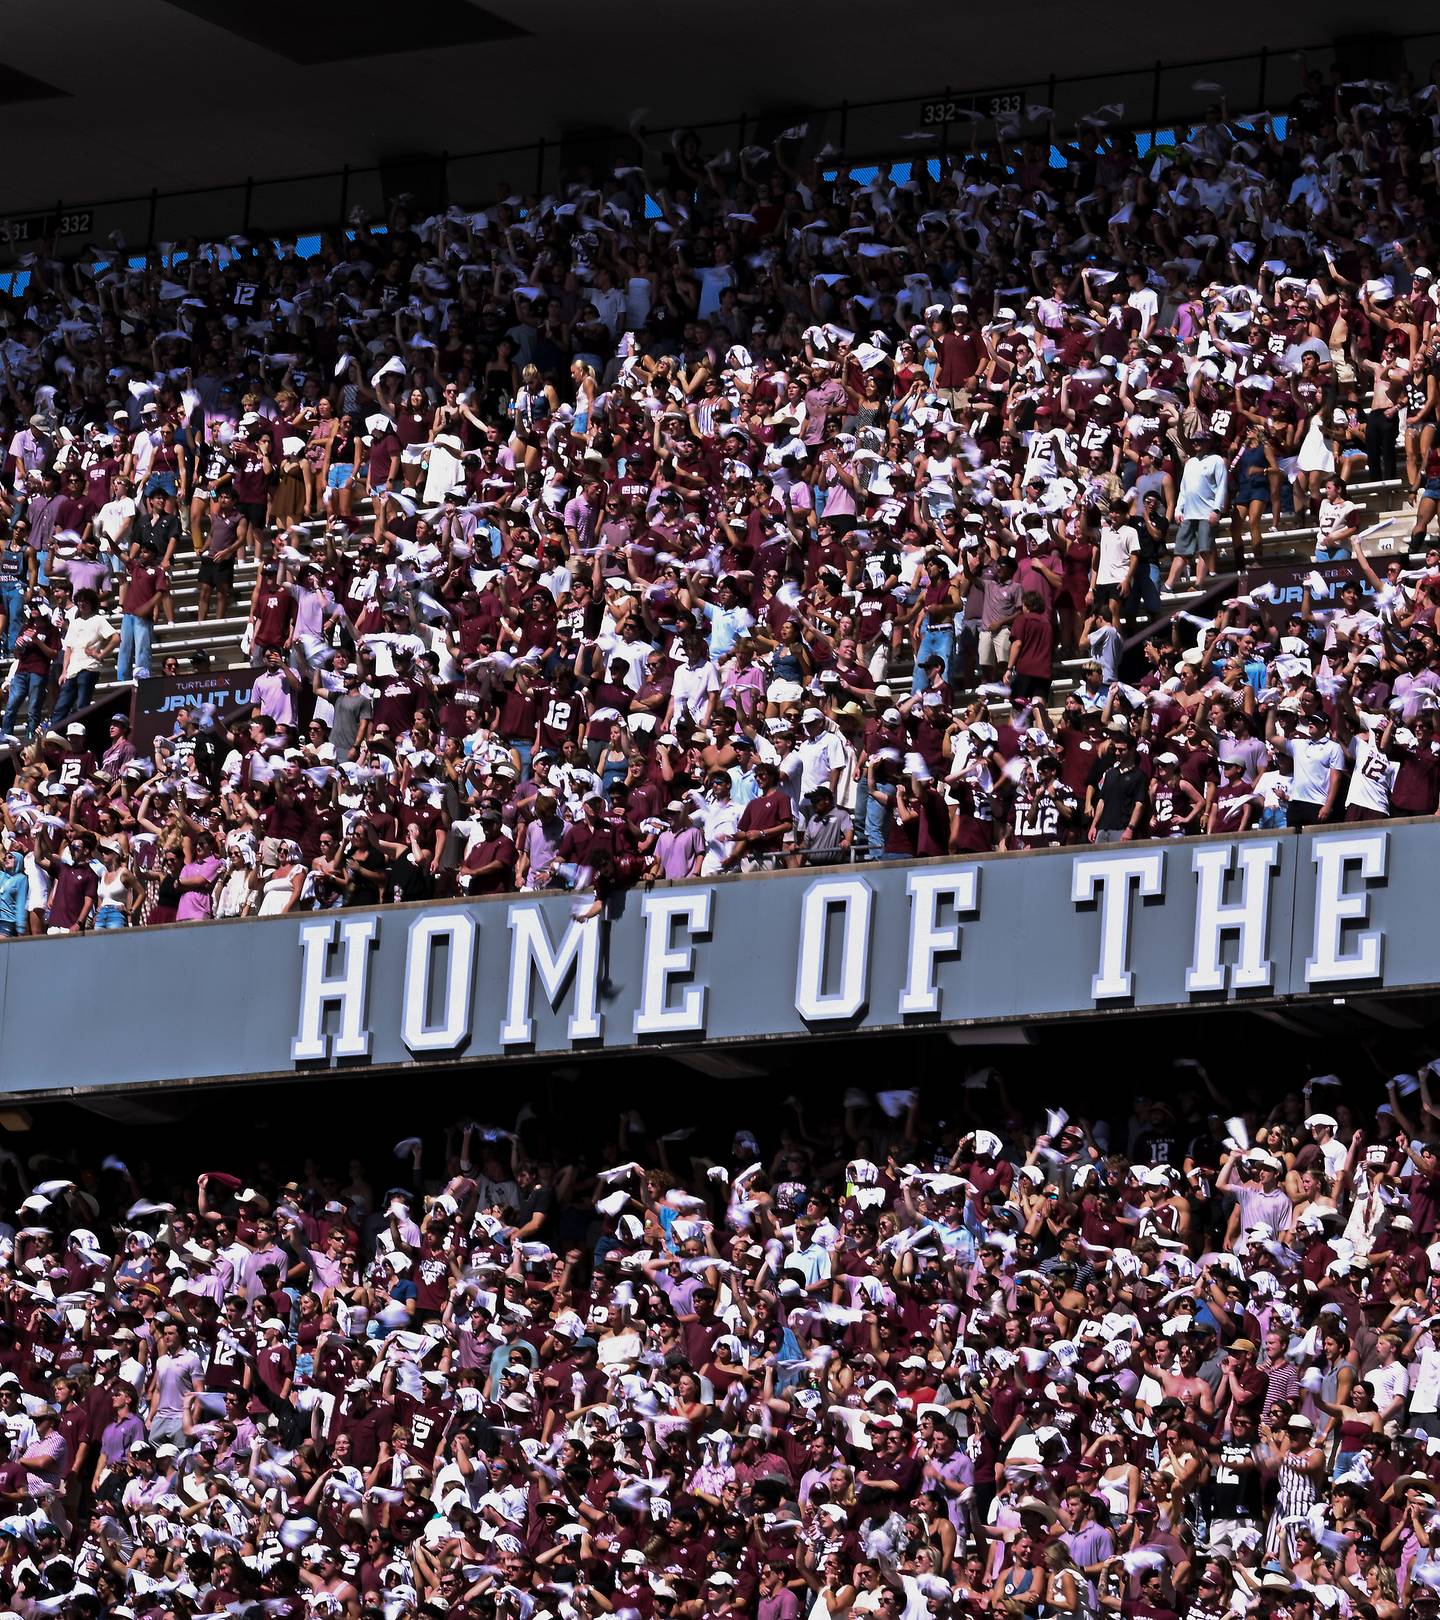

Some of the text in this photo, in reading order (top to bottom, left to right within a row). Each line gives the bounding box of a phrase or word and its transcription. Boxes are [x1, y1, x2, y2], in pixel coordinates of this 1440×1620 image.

[924, 103, 956, 124] 332
[990, 96, 1021, 115] 333
[60, 214, 89, 233] 332
[234, 286, 256, 306] 12
[1210, 411, 1230, 436] 12
[1081, 425, 1112, 450] 12
[1031, 440, 1053, 461] 12
[543, 700, 571, 731] 12
[59, 763, 81, 785] 12
[1362, 756, 1387, 782] 12
[1156, 799, 1173, 822] 12
[291, 887, 715, 1061] HOME
[797, 865, 981, 1022] OF
[1071, 830, 1389, 1001] THE
[1151, 1143, 1169, 1163] 12
[213, 1341, 236, 1366] 12
[609, 1542, 620, 1553] 12
